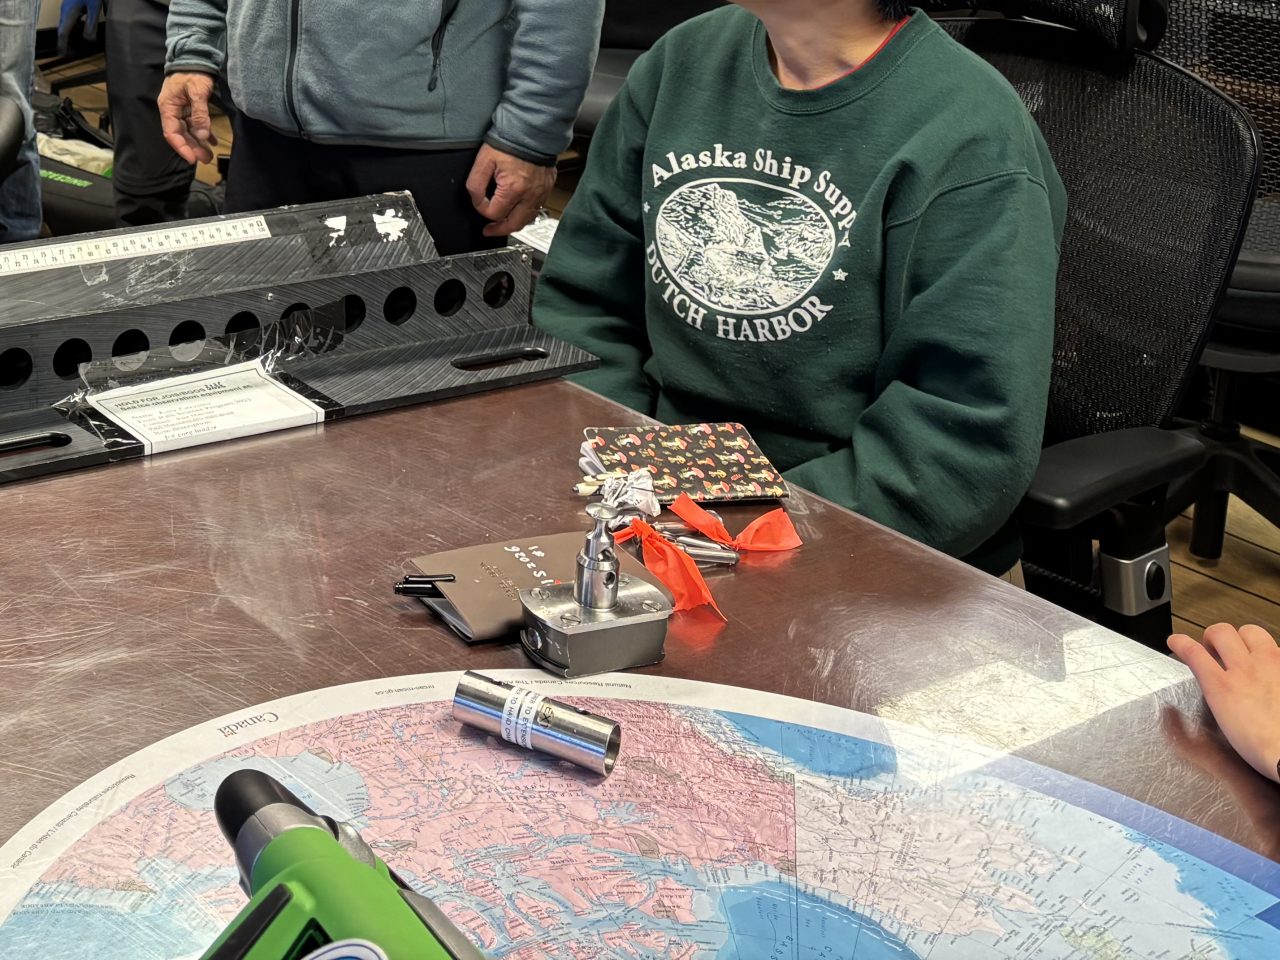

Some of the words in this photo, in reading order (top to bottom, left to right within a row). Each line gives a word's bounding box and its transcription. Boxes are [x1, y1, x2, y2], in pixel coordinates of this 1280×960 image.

[650, 143, 748, 189] Alaska
[753, 148, 812, 190] Ship
[646, 239, 707, 331] DUTCH
[716, 294, 834, 343] HARBOR
[504, 545, 536, 569] 2026
[506, 707, 514, 725] HAND
[525, 706, 532, 714] TO
[216, 711, 280, 739] Canada
[57, 810, 78, 826] Canada
[10, 850, 32, 869] Canada
